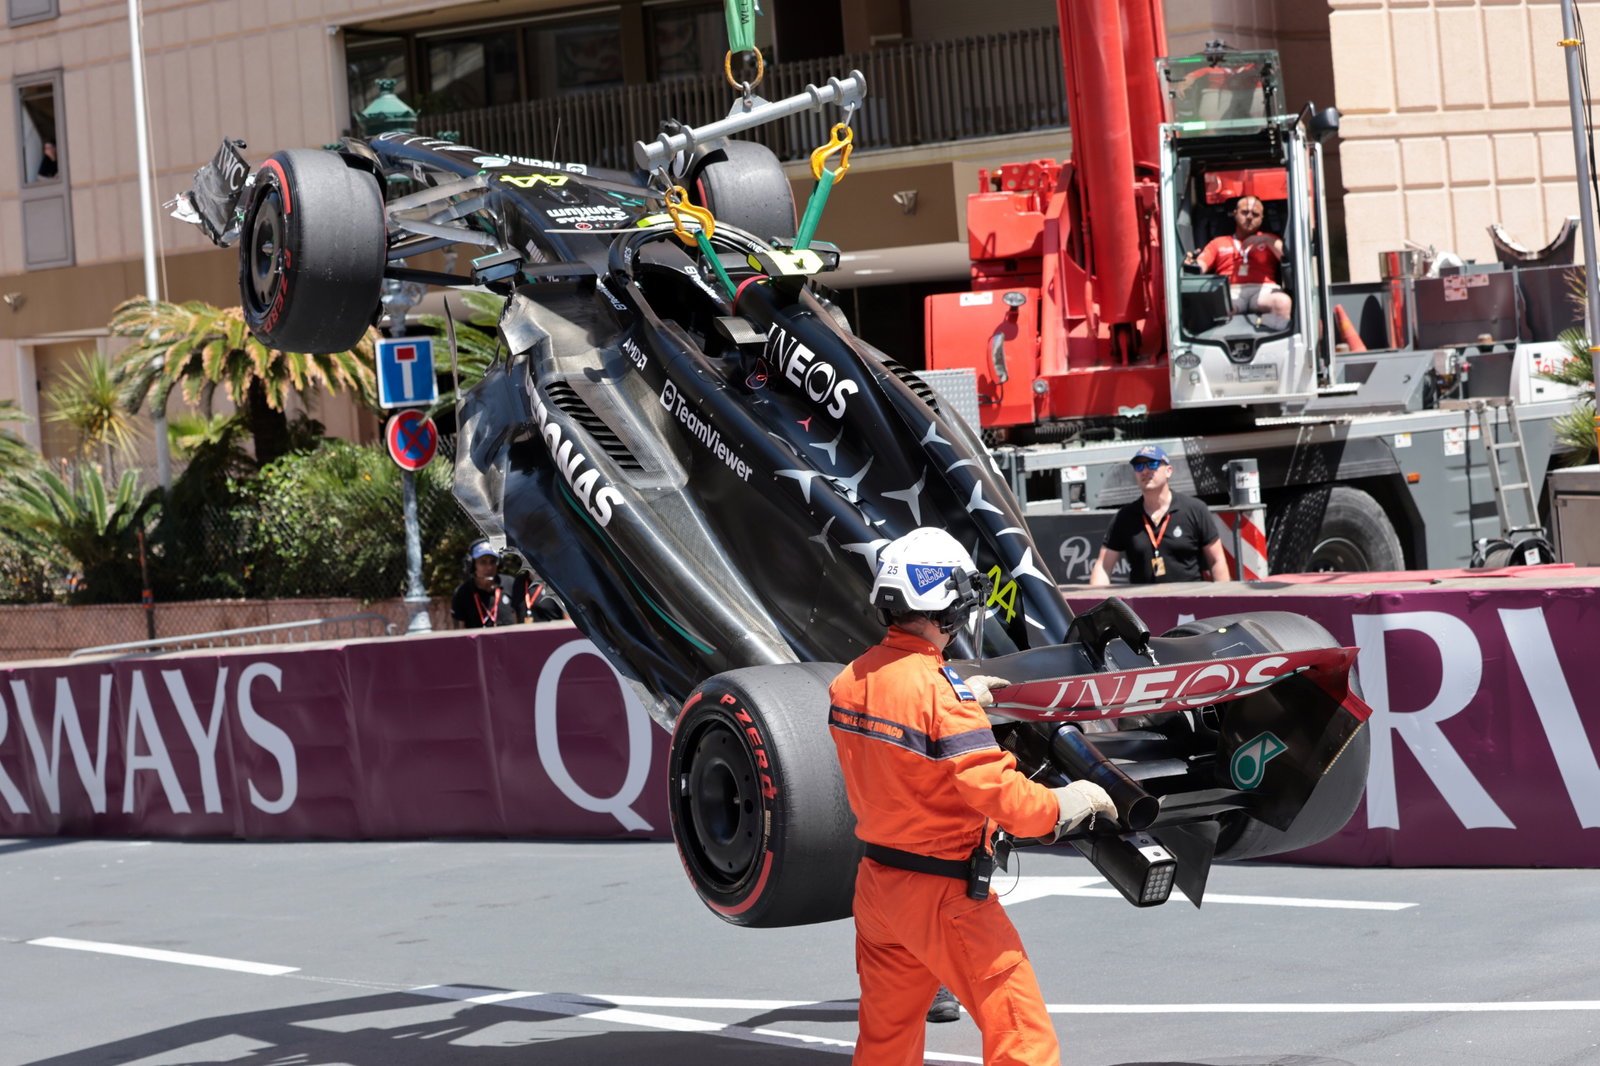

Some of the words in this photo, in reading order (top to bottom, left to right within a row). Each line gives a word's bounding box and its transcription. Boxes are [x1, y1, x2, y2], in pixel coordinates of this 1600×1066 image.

[217, 142, 245, 191] IWC
[763, 321, 859, 420] INEOS
[674, 391, 753, 483] TeamViewer
[887, 565, 898, 575] 25
[914, 568, 945, 588] ACM
[1039, 656, 1289, 718] INEOS
